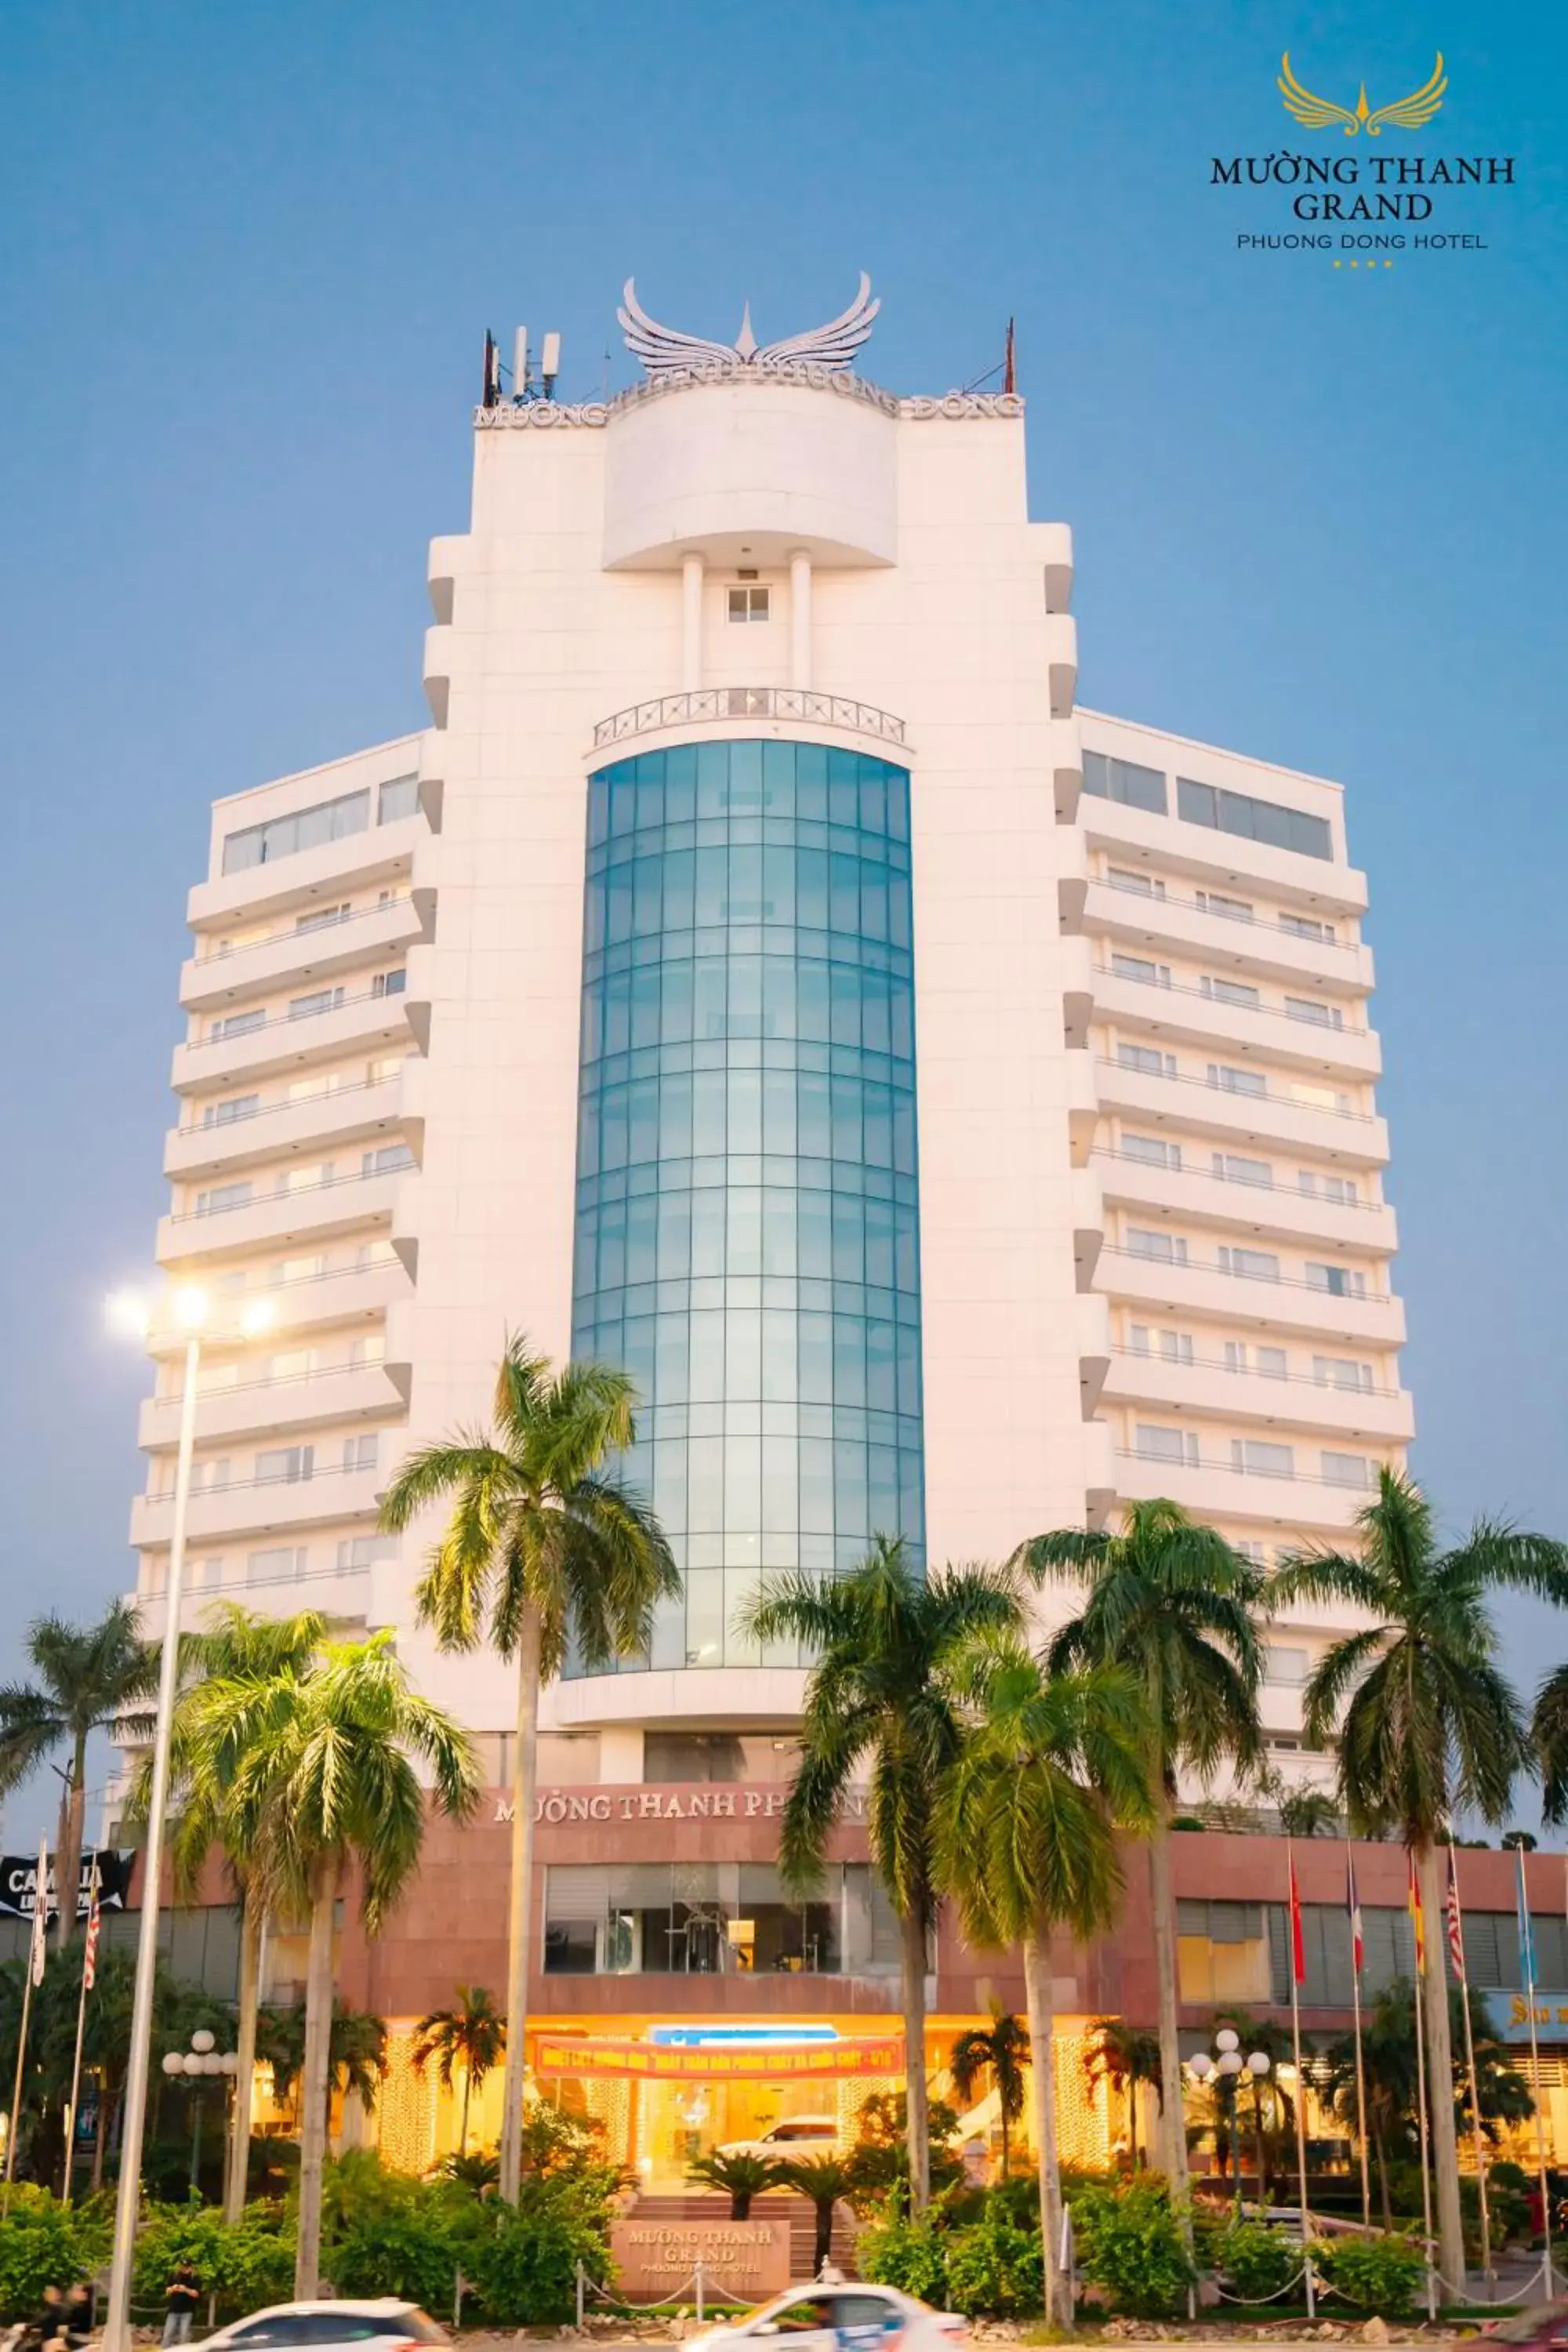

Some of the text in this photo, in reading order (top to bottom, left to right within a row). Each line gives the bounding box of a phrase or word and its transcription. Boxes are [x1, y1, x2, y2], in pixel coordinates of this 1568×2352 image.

[619, 1792, 735, 1820] THANH
[704, 2230, 772, 2245] THANH
[664, 2247, 735, 2263] GRAND
